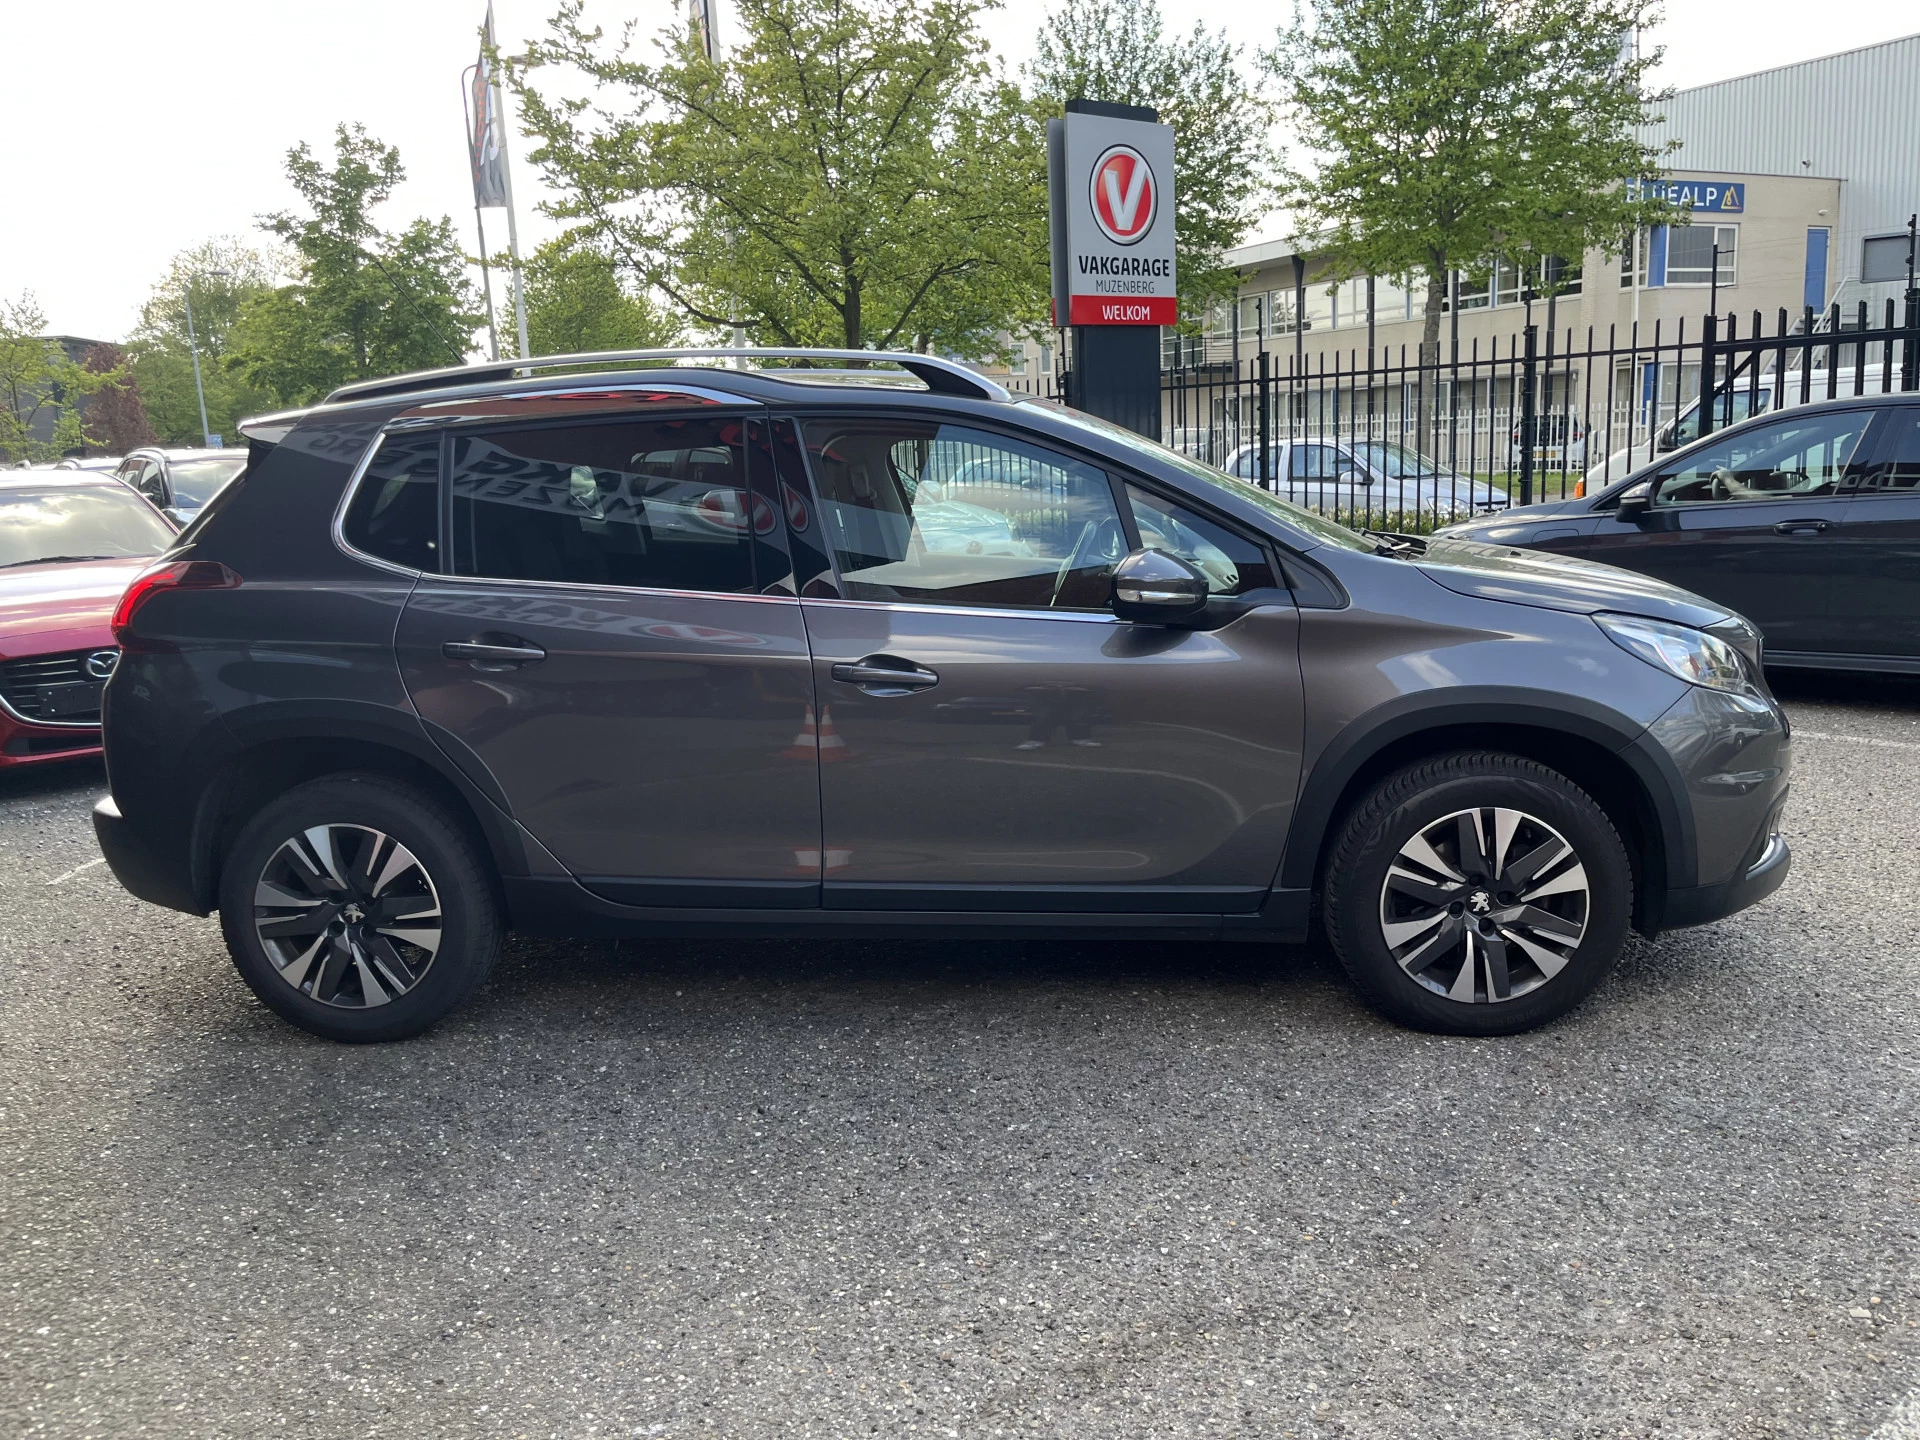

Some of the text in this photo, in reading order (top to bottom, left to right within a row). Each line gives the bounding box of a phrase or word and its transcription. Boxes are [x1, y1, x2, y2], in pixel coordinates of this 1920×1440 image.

[1079, 255, 1170, 277] VAKGARAGE
[1095, 279, 1155, 294] MUZENBERG
[1102, 305, 1151, 321] WELKOM
